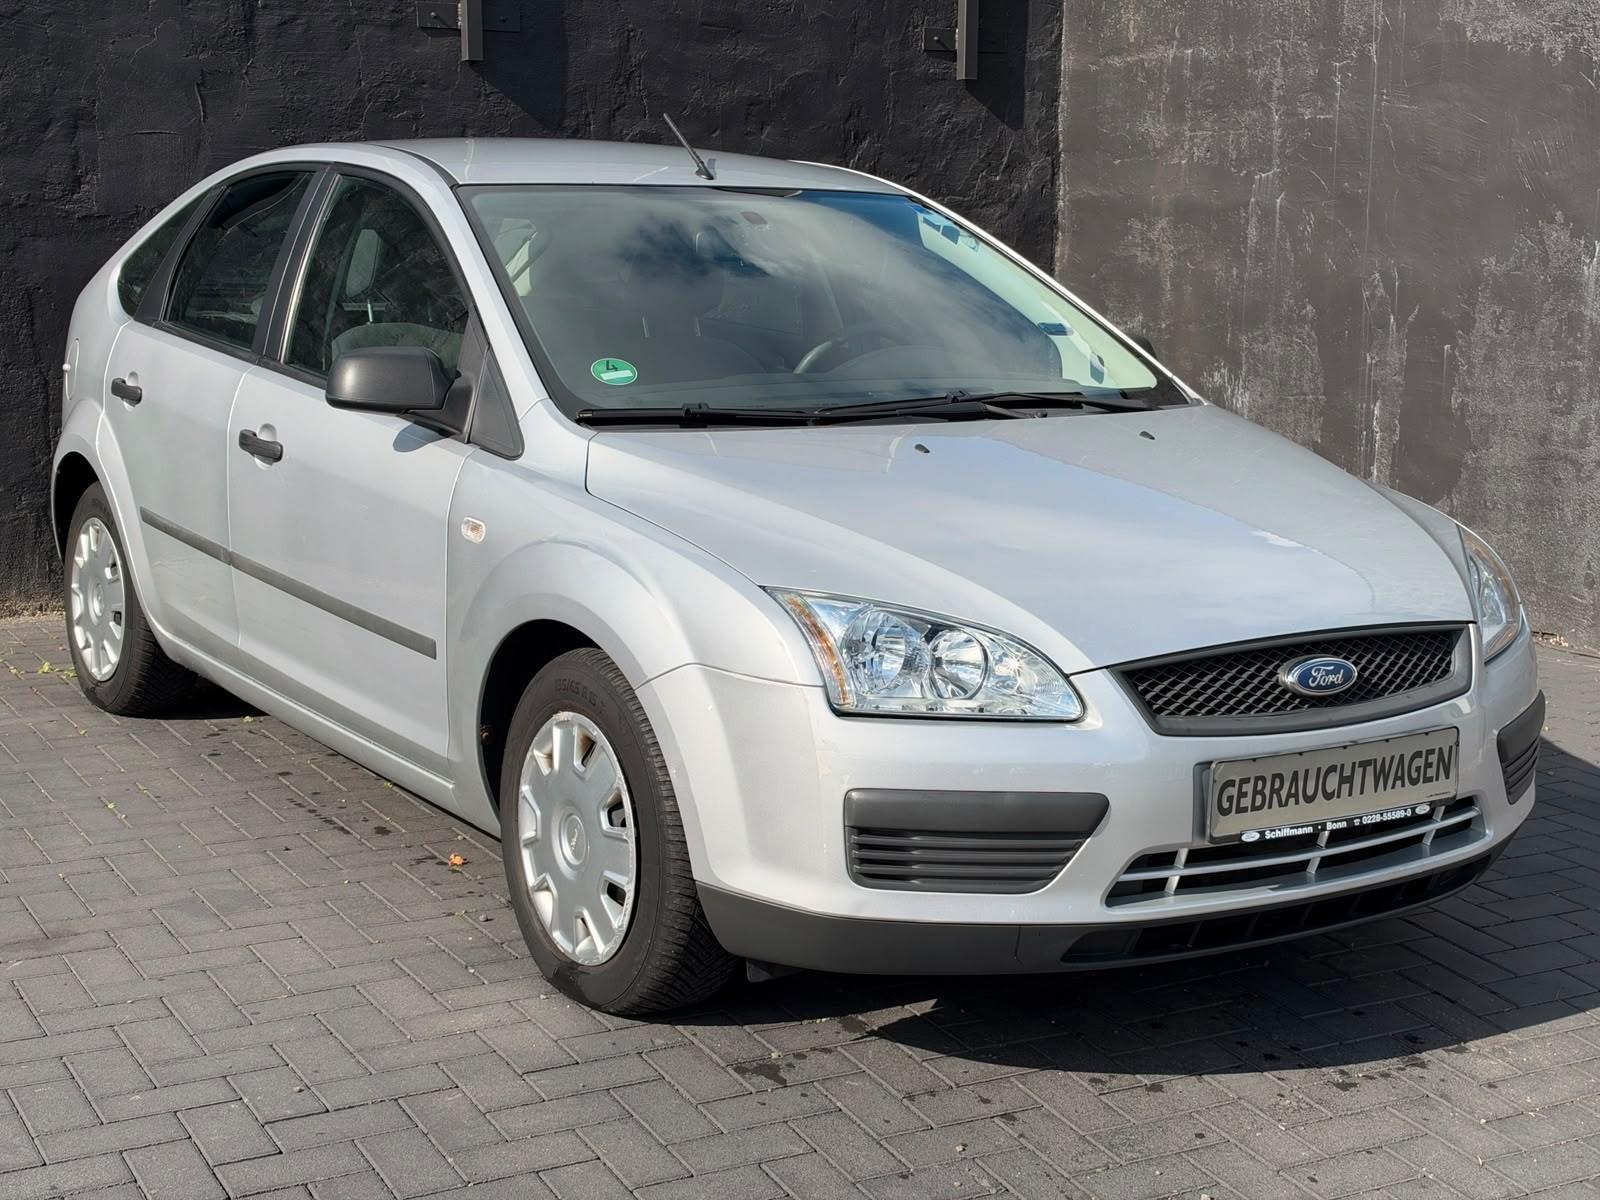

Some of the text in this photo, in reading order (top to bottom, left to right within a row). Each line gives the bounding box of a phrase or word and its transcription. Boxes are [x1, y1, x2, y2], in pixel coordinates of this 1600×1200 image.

[1308, 665, 1344, 687] Ford
[1216, 745, 1453, 816] GEBRAUCHTWAGEN
[1264, 826, 1313, 839] Schiffmann
[1326, 821, 1347, 830] Bonn
[1362, 808, 1412, 825] 0228-55589-0
